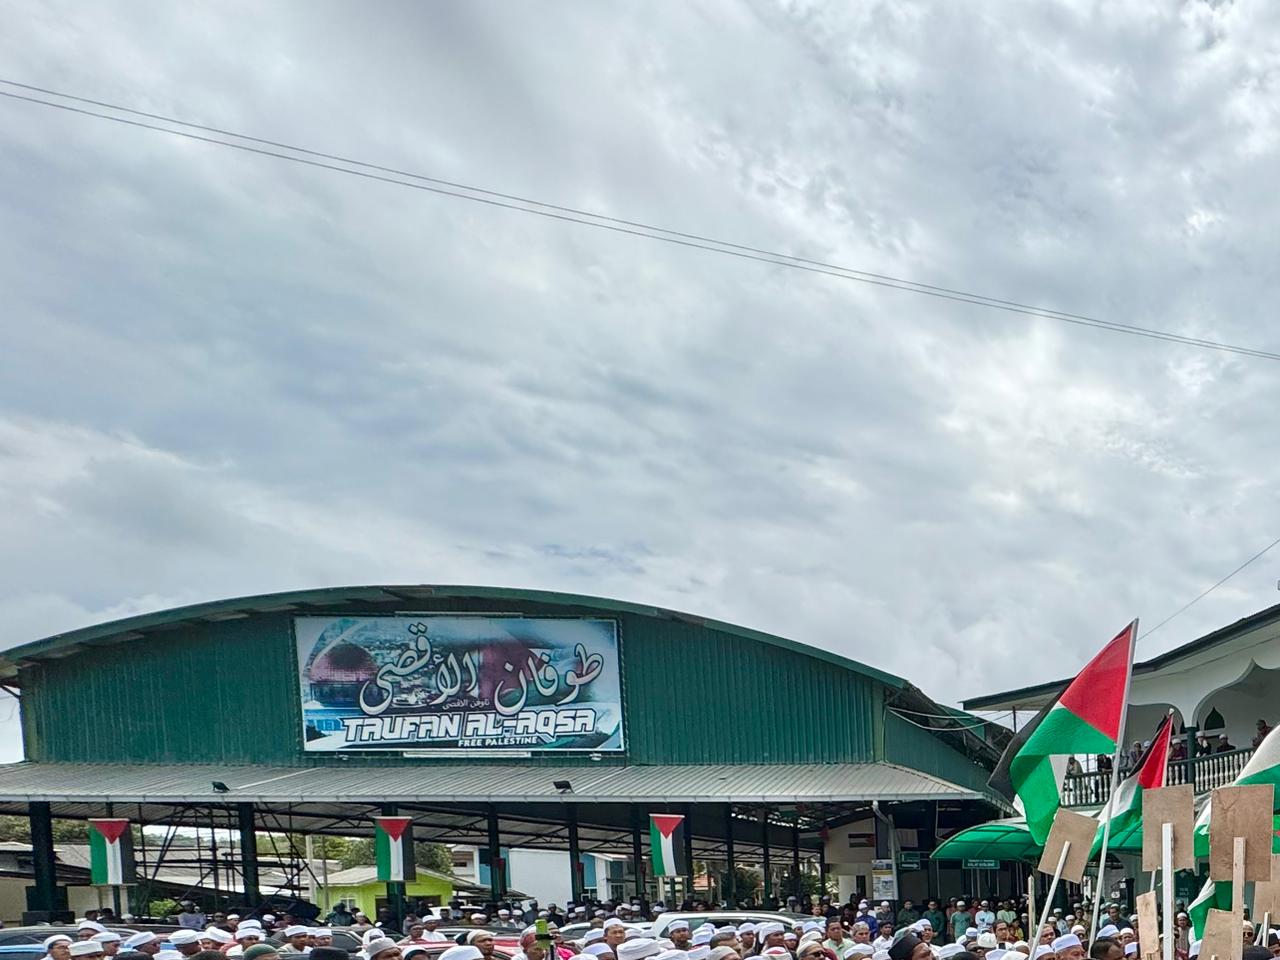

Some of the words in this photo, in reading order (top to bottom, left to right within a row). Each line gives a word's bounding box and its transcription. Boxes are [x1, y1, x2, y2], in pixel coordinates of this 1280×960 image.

[343, 714, 461, 742] TAUFAN
[466, 709, 595, 738] AL-AQSA
[458, 738, 482, 747] FREE
[485, 736, 538, 746] PALESTINE
